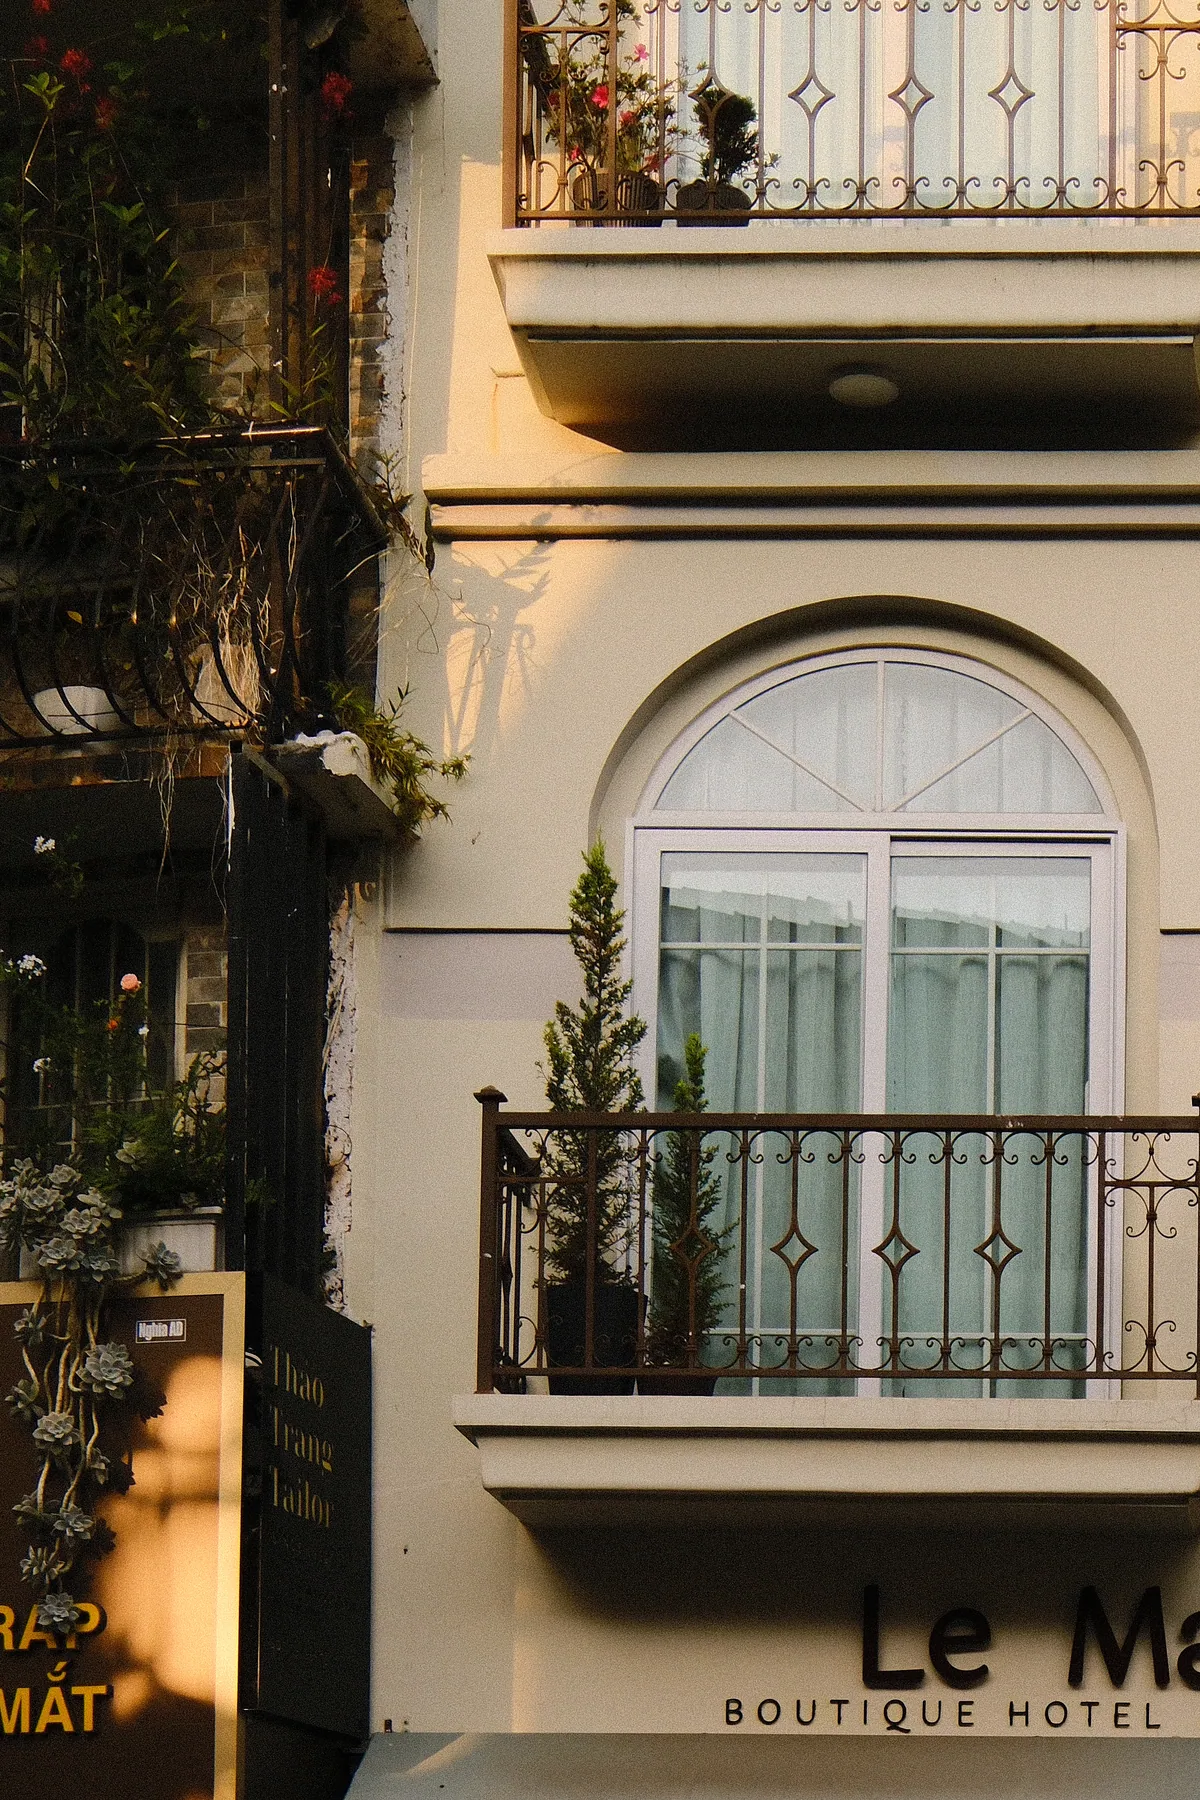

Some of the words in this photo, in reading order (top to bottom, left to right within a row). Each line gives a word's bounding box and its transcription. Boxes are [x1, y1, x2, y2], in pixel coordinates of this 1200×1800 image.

[169, 1320, 184, 1337] AD
[269, 1404, 334, 1475] Trang
[269, 1464, 336, 1529] Tailor
[862, 1583, 991, 1690] Le
[722, 1698, 978, 1734] BOUTIQUE
[1007, 1700, 1162, 1730] HOTEL
